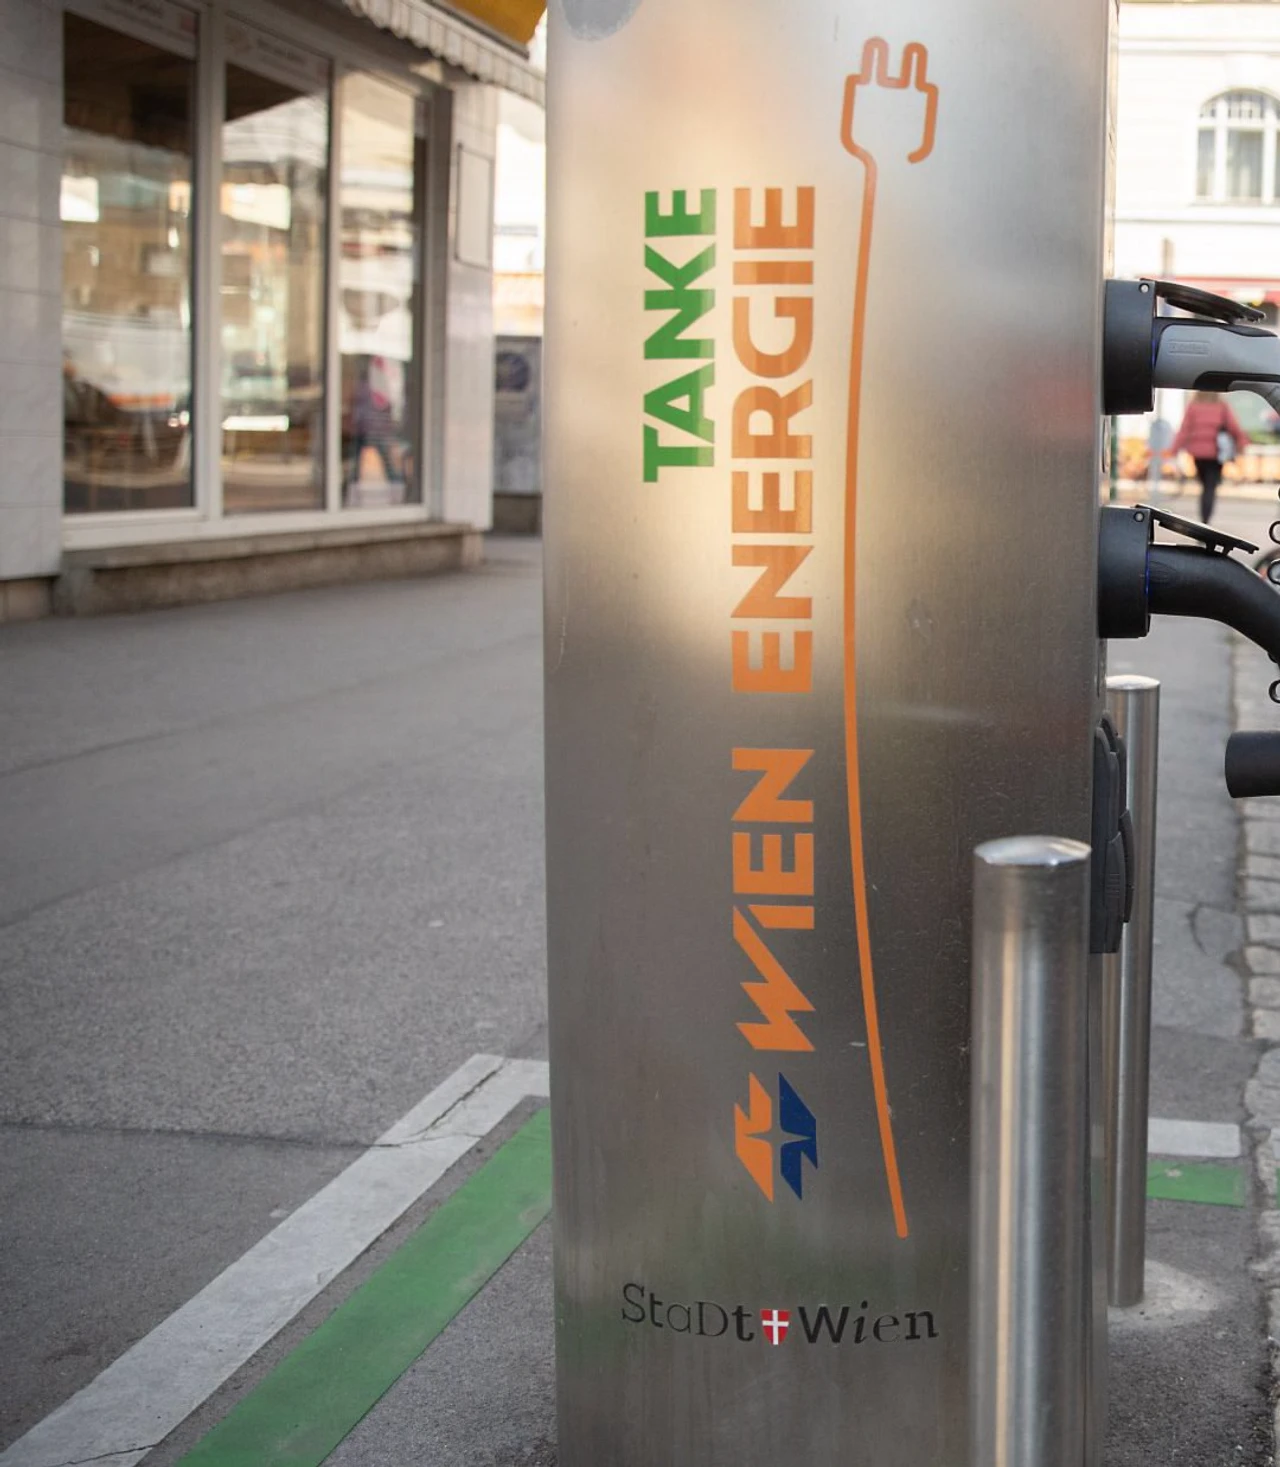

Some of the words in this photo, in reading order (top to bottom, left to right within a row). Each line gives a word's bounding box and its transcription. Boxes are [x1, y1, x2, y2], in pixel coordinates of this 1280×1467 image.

[643, 187, 718, 483] TANKE
[731, 186, 815, 694] ENERGIE
[732, 747, 816, 1053] WIEN
[797, 1300, 939, 1345] Wien
